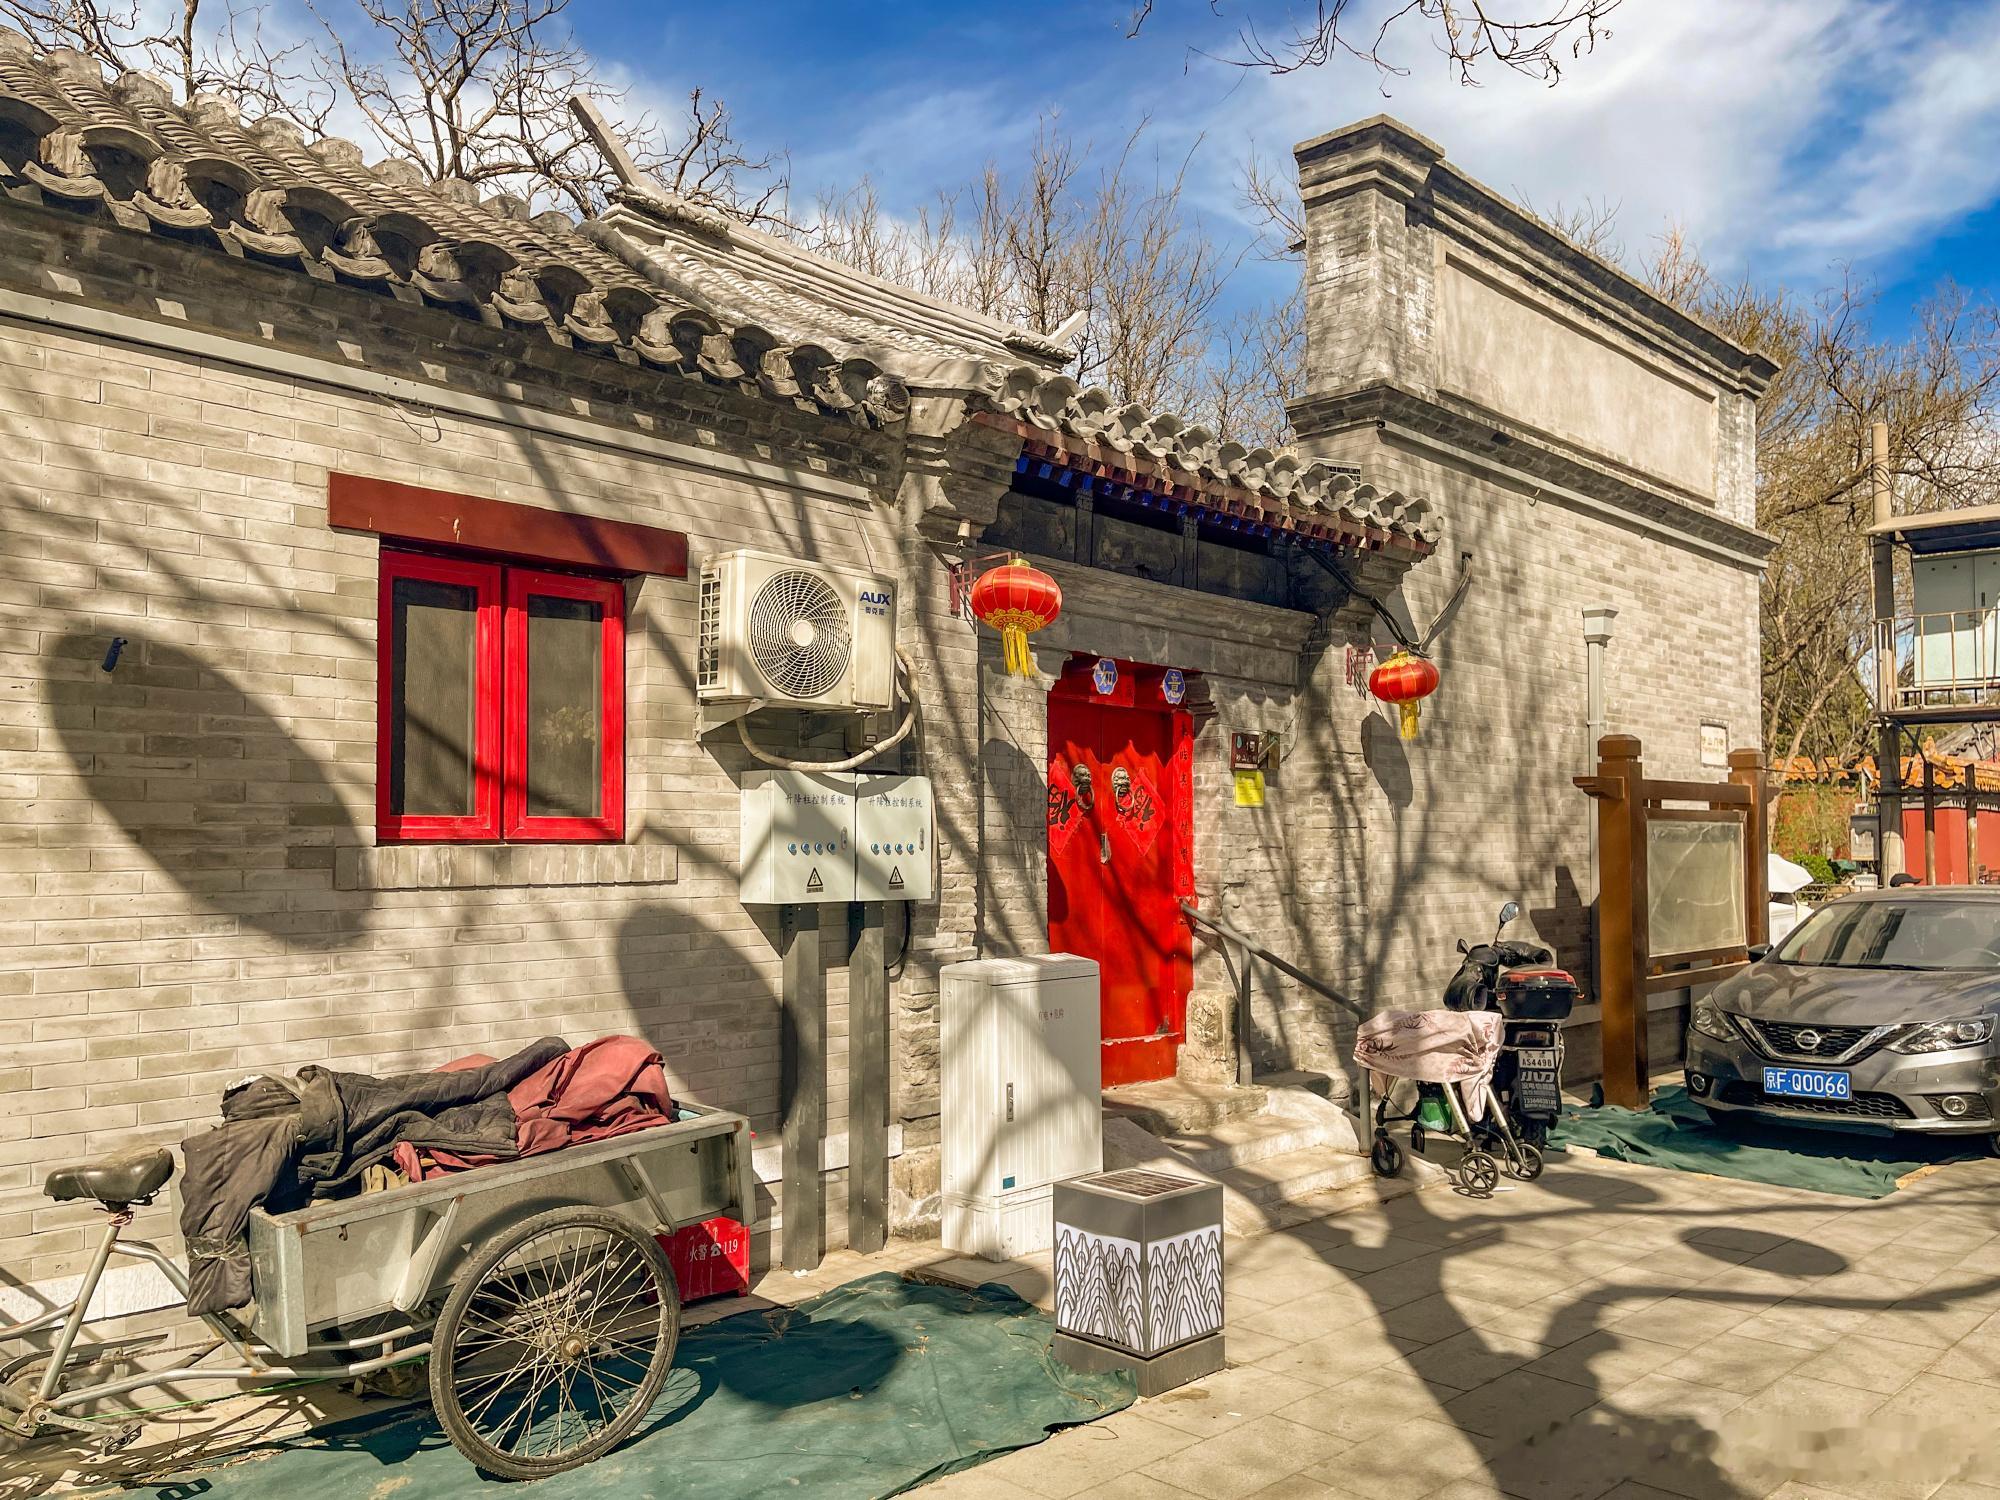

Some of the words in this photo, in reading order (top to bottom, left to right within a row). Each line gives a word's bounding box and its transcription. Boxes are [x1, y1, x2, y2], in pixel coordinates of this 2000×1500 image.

[860, 591, 890, 606] AUX
[1167, 673, 1181, 698] 意
[785, 792, 847, 806] 升降柱控制系统
[868, 796, 923, 808] 升降柱控制系统
[689, 1243, 708, 1263] 火警
[724, 1239, 738, 1255] 119
